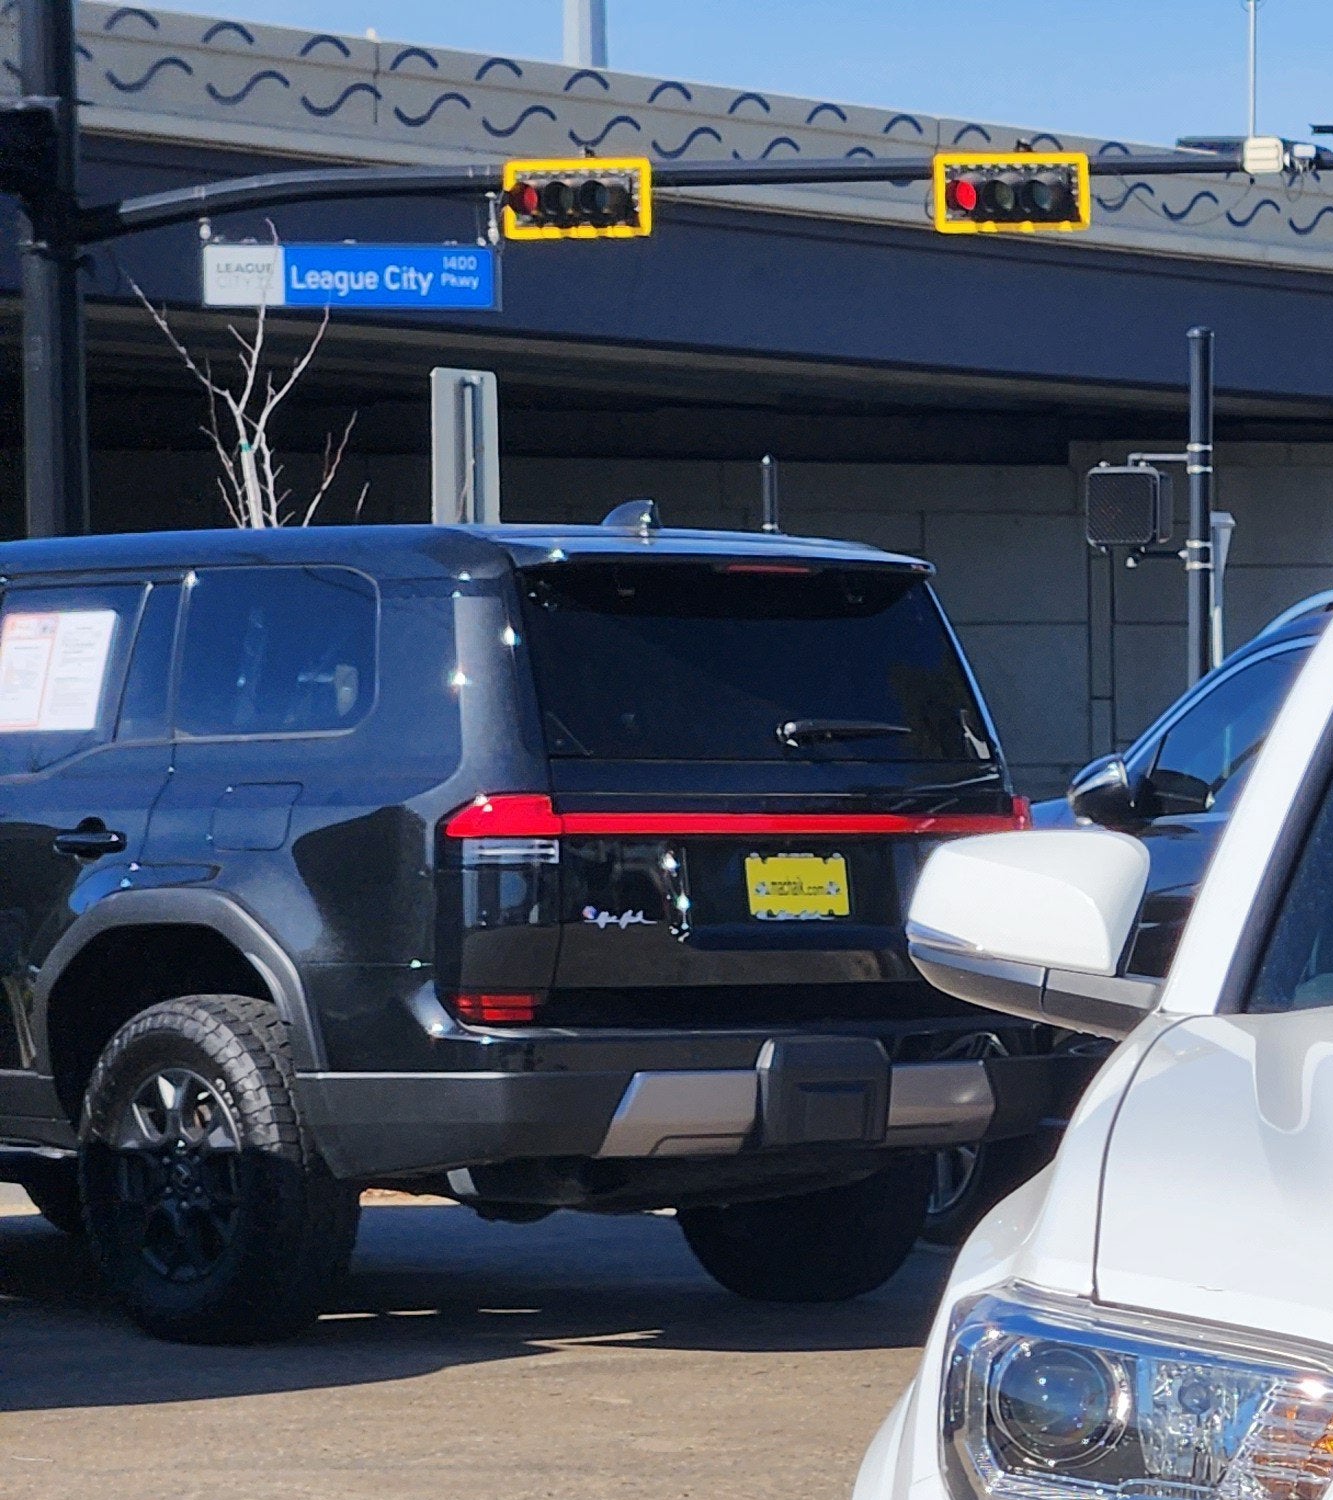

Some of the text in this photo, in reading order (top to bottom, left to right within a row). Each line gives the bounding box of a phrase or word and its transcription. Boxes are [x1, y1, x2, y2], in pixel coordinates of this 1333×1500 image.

[442, 256, 477, 271] 1400
[290, 265, 379, 296] League
[384, 265, 433, 296] City
[441, 274, 479, 290] Pkwy
